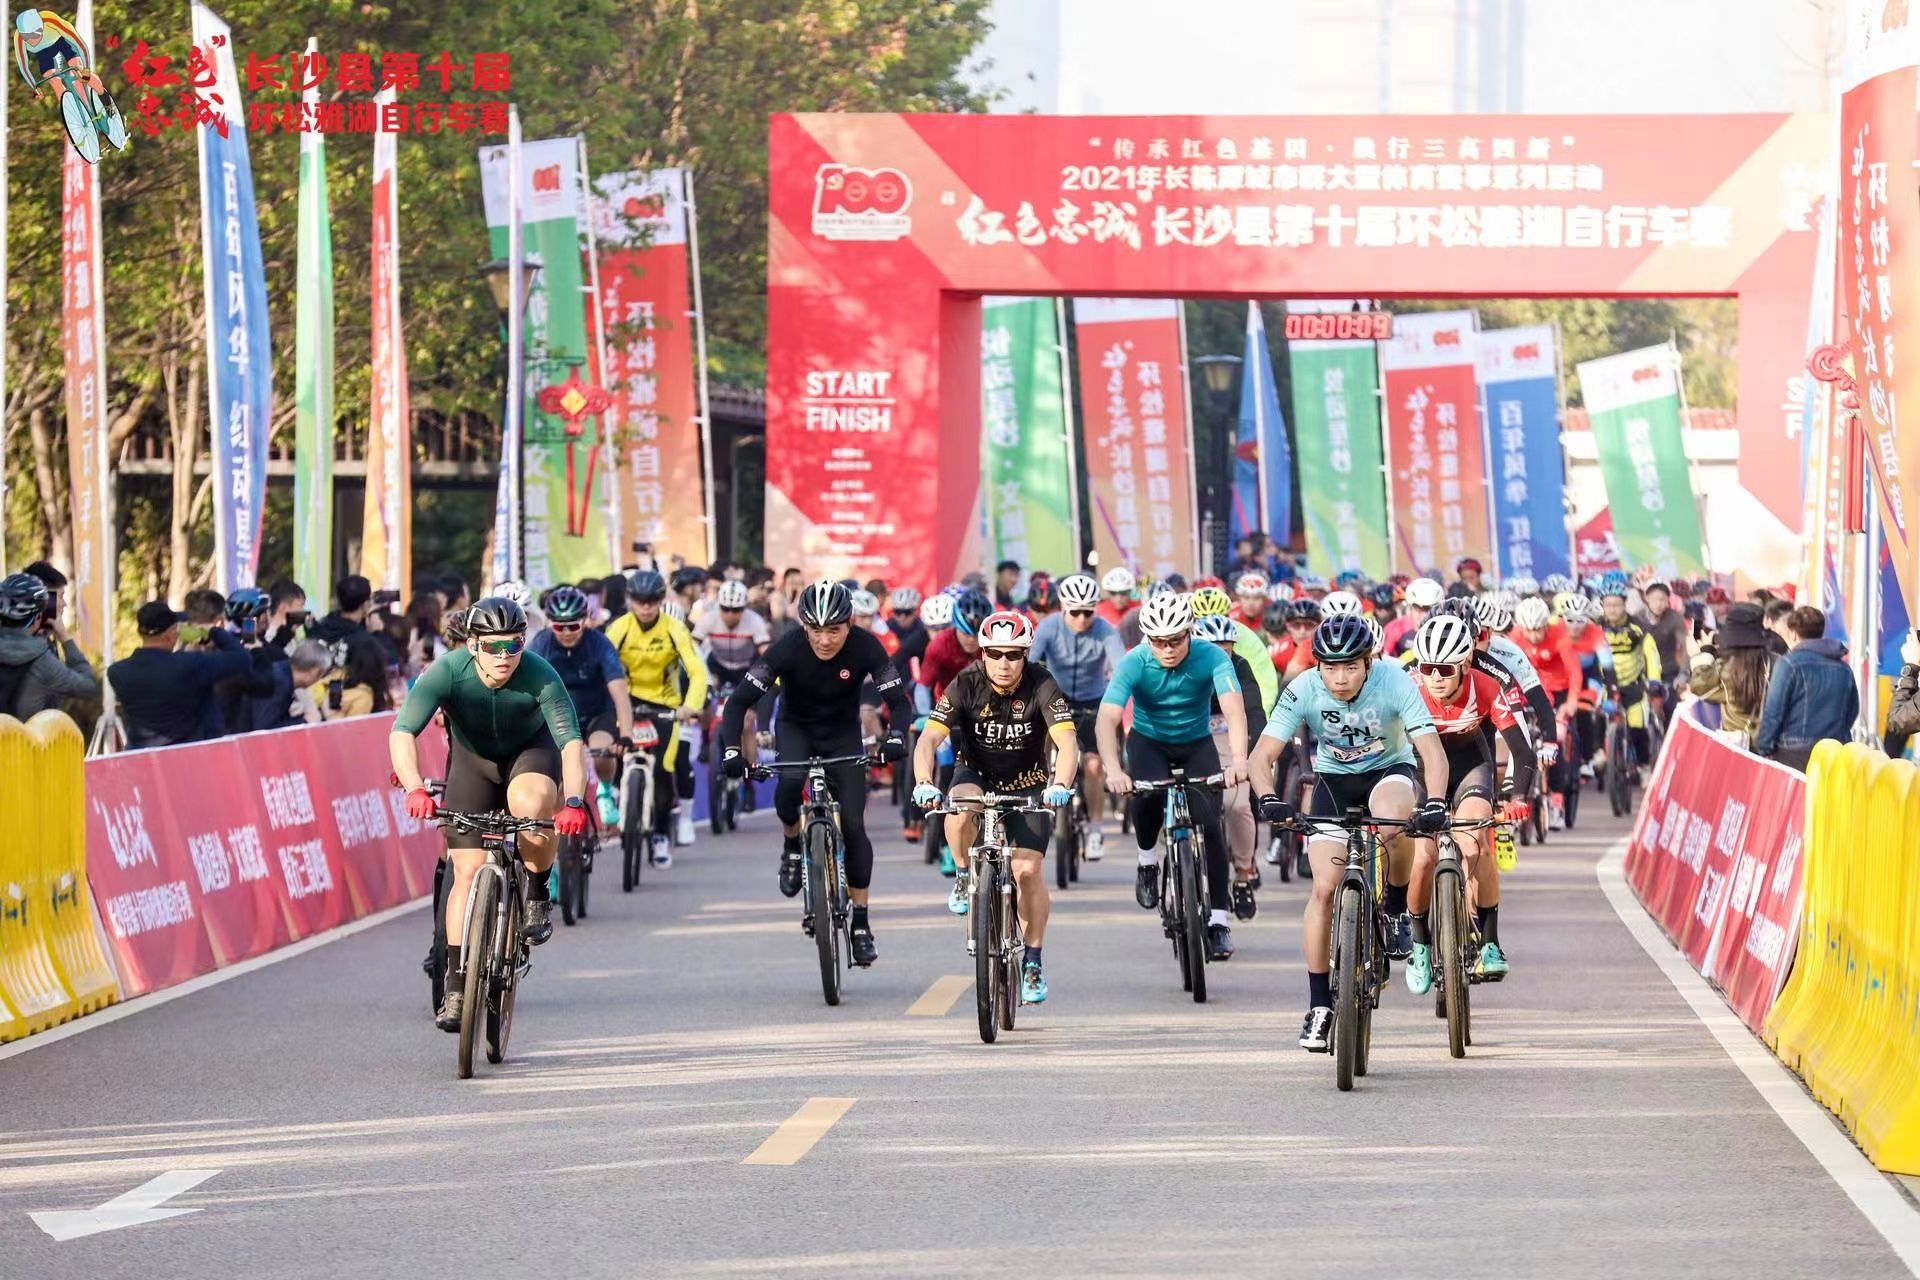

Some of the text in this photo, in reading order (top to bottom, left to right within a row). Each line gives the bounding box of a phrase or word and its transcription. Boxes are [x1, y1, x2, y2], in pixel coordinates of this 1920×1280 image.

[1285, 315, 1390, 340] 00:00:09
[806, 371, 890, 396] START
[806, 407, 890, 432] FINISH
[974, 719, 1033, 739] L'ÉTAPE
